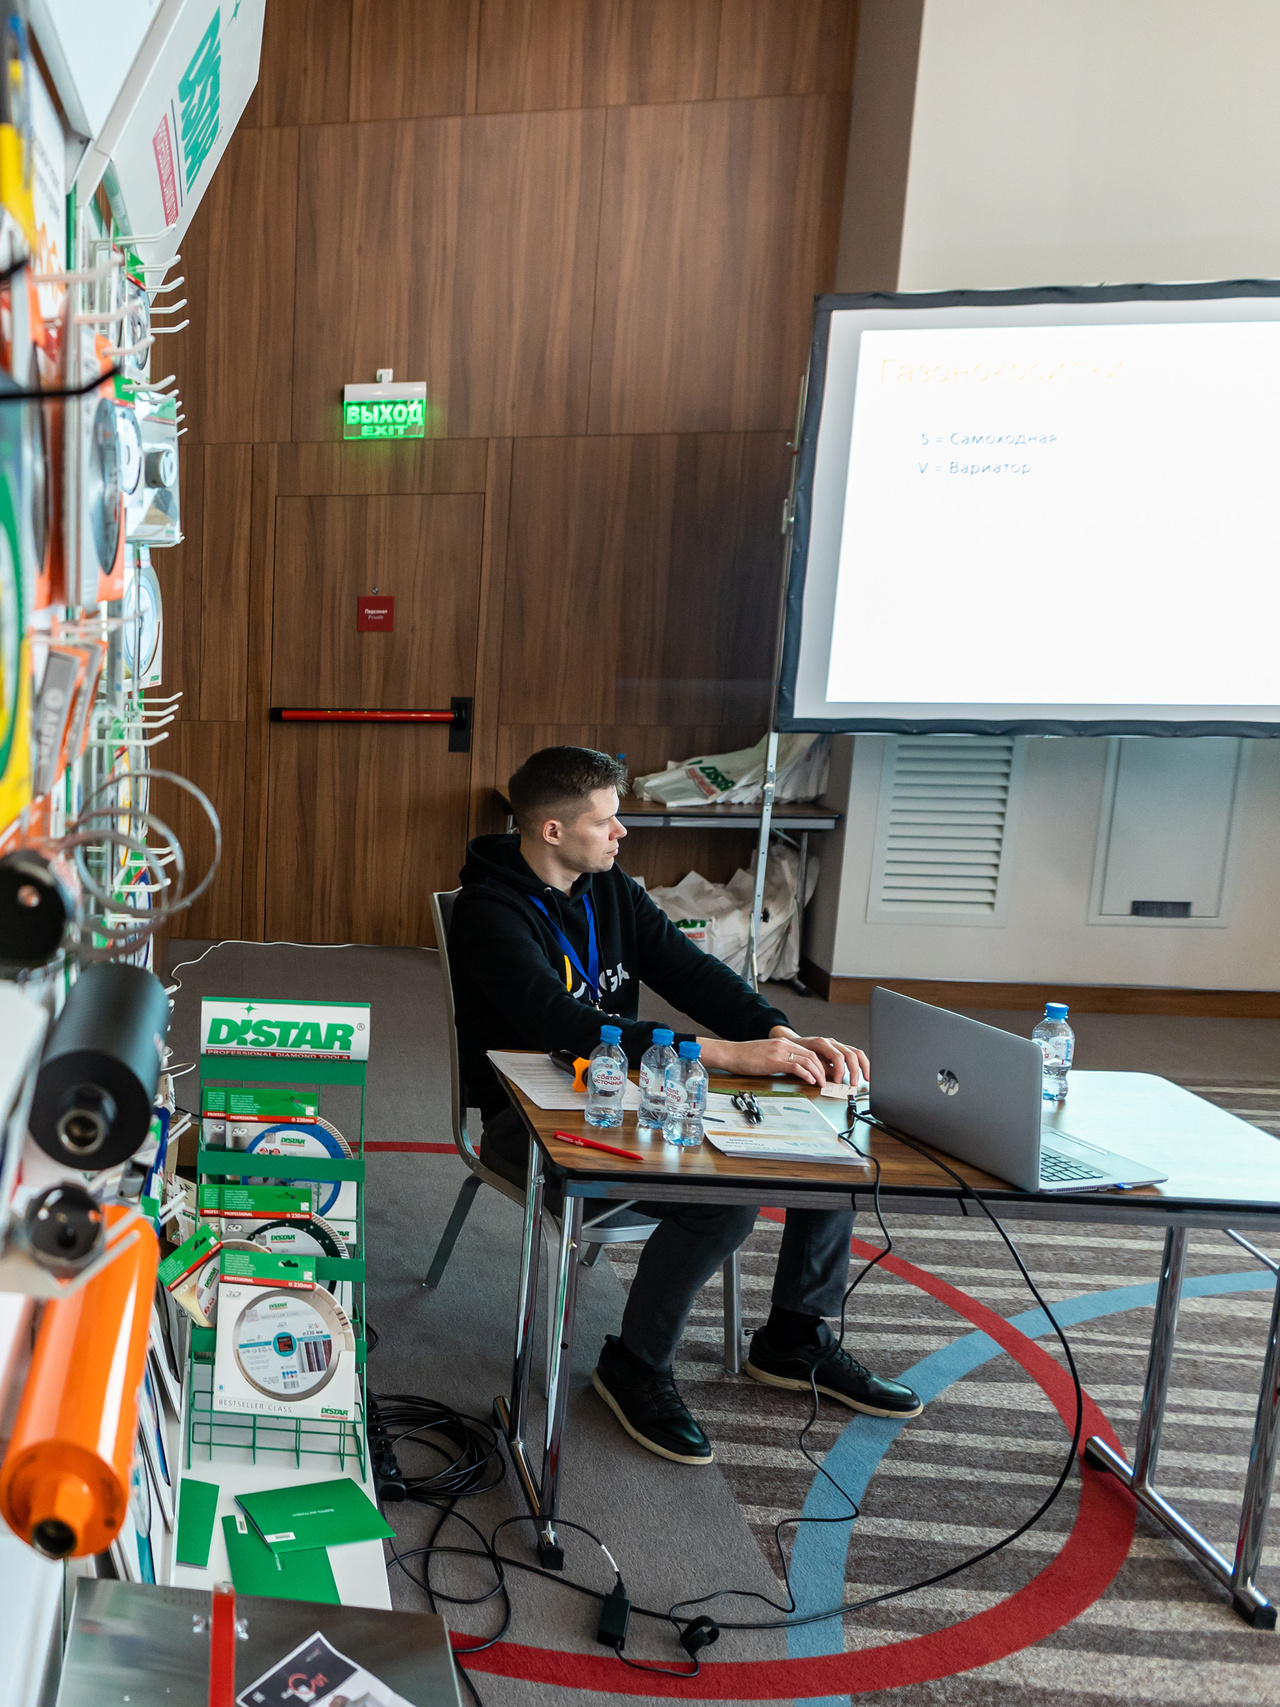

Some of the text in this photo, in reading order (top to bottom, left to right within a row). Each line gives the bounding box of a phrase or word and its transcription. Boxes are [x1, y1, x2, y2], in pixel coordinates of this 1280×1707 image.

[346, 402, 424, 426] ВЫХОД
[361, 425, 408, 437] EXIT
[920, 432, 930, 446] S
[949, 431, 1059, 446] Самоходная
[917, 461, 929, 474] V
[948, 460, 1032, 476] Вариатор
[206, 1017, 355, 1051] DISTAR
[206, 1049, 274, 1058] PROFESSIONAL
[223, 1275, 254, 1283] PROFESSIONAL
[293, 1281, 313, 1289] 230mm
[218, 1399, 293, 1413] BESTSELLER CLASS
[320, 1407, 349, 1417] DISTAR
